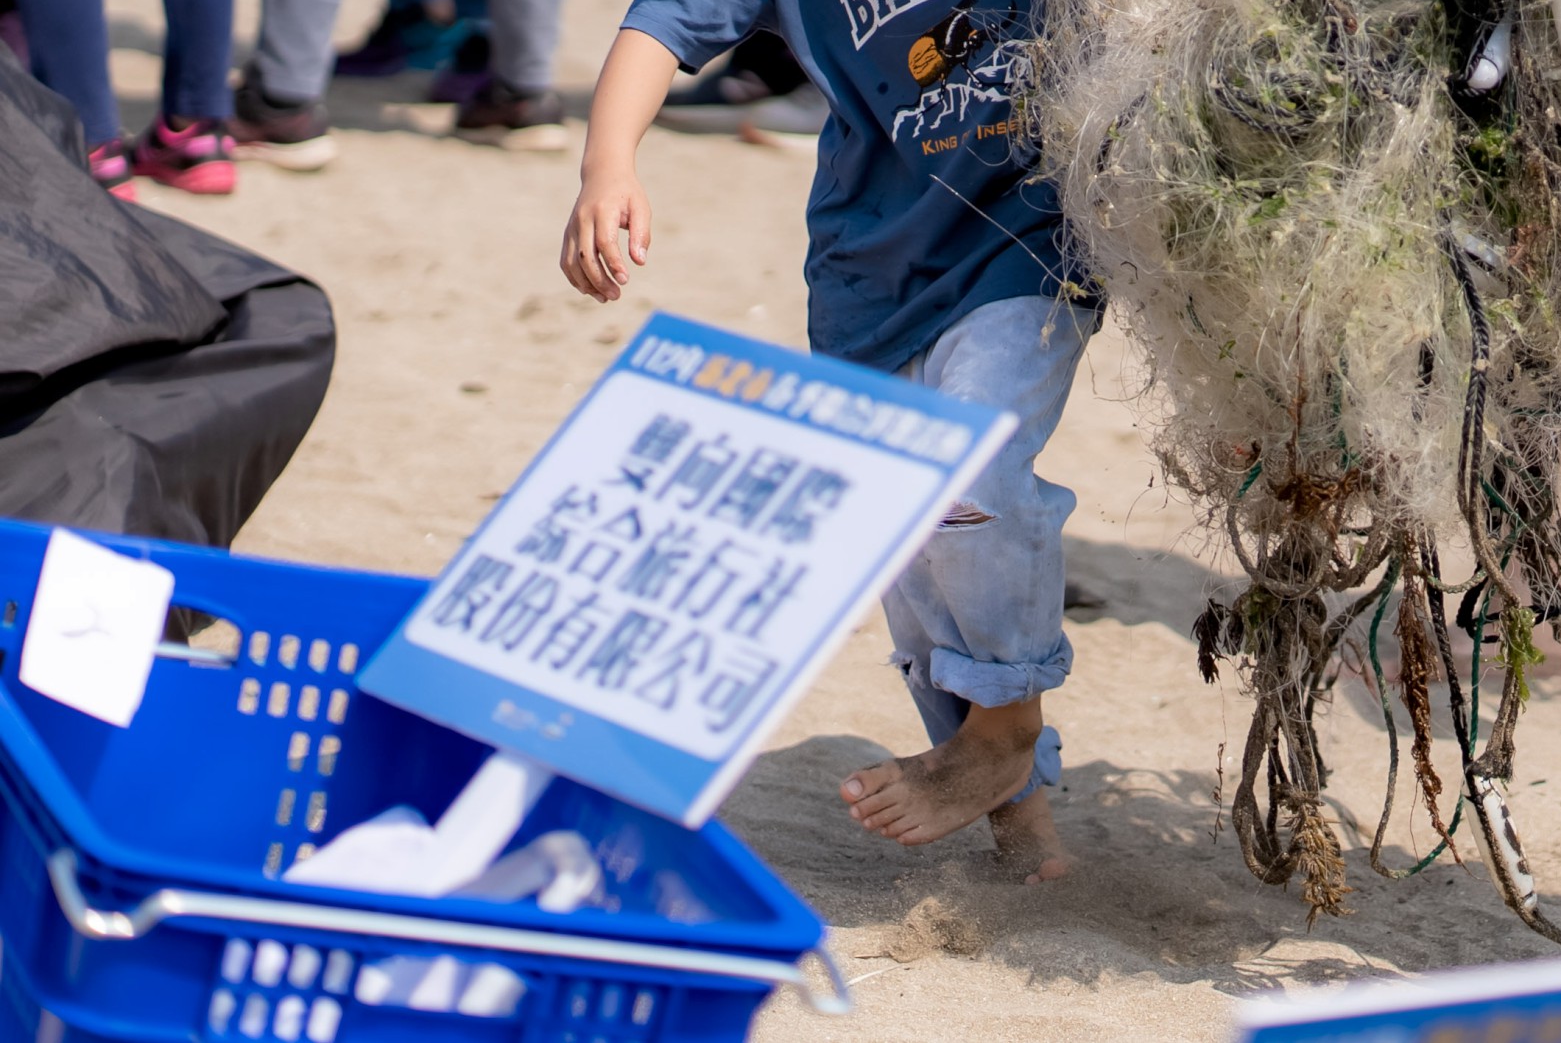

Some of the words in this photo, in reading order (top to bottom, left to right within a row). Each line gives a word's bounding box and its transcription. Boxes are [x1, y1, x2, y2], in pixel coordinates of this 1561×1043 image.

[921, 135, 958, 156] KING
[599, 412, 853, 545] 雙向國際
[515, 484, 811, 642] 綜合旅行社
[431, 553, 779, 734] 股份有限公司
